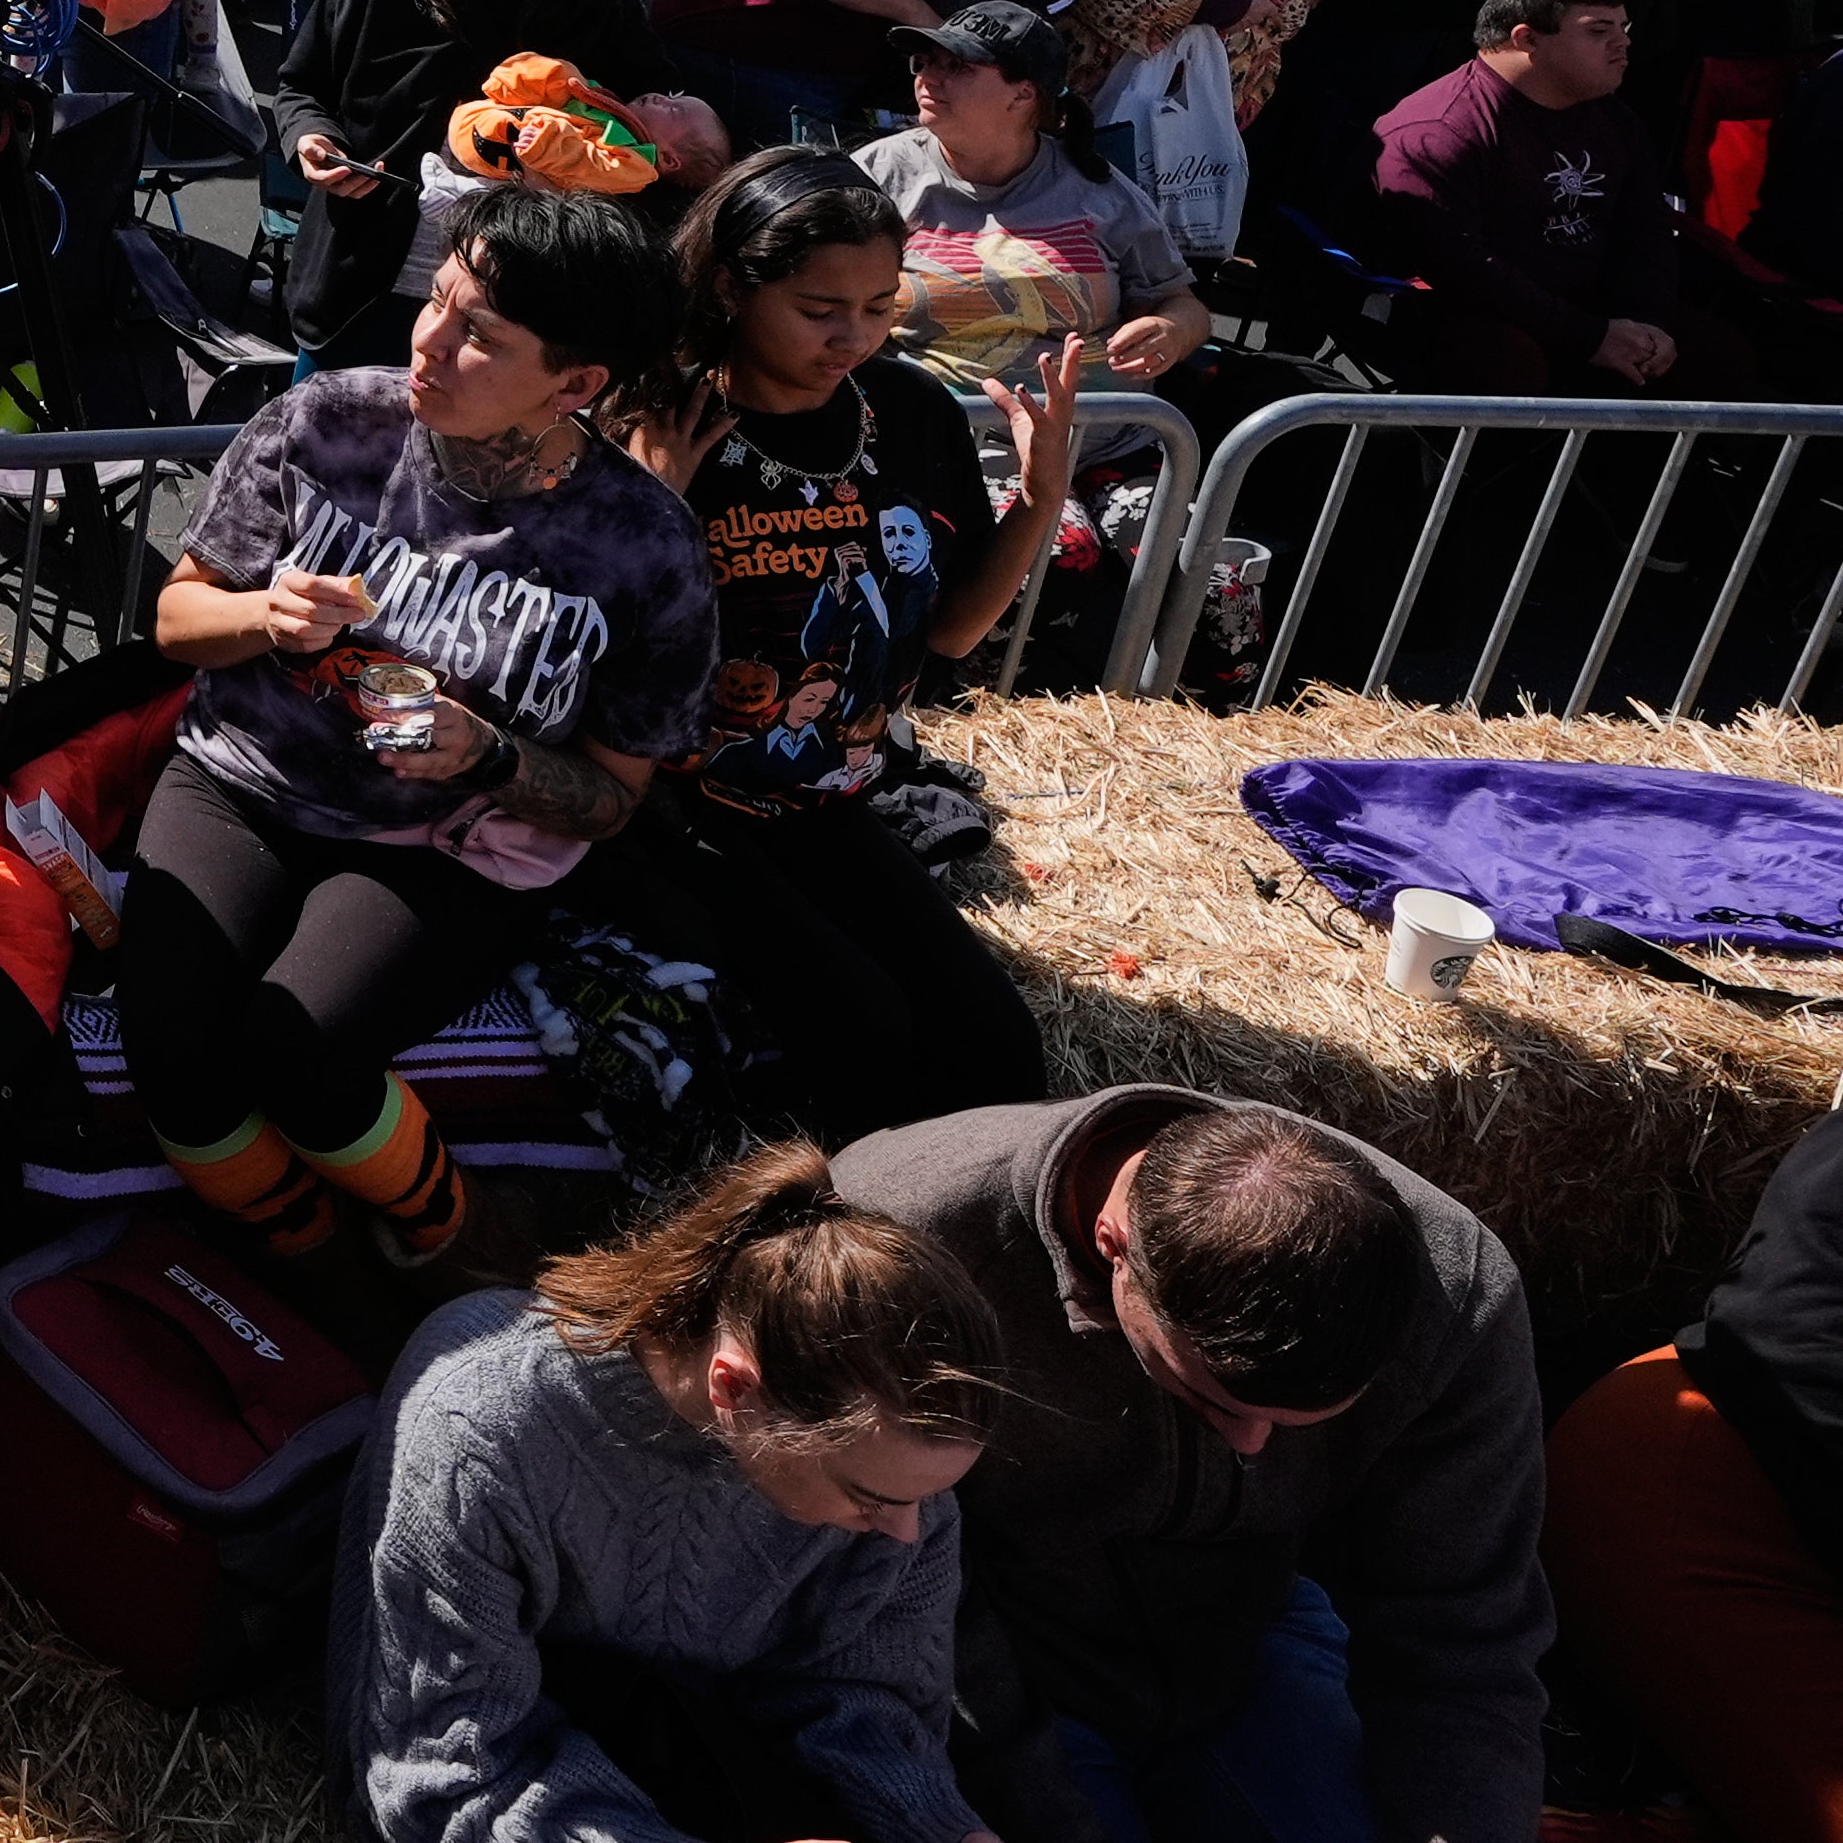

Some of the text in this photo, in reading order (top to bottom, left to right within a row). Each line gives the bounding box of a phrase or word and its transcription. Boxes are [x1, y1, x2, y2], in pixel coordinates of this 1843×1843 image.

[1180, 153, 1230, 187] You
[706, 503, 869, 549] alloween
[709, 541, 830, 587] Safety
[163, 1263, 285, 1362] 49ERS
